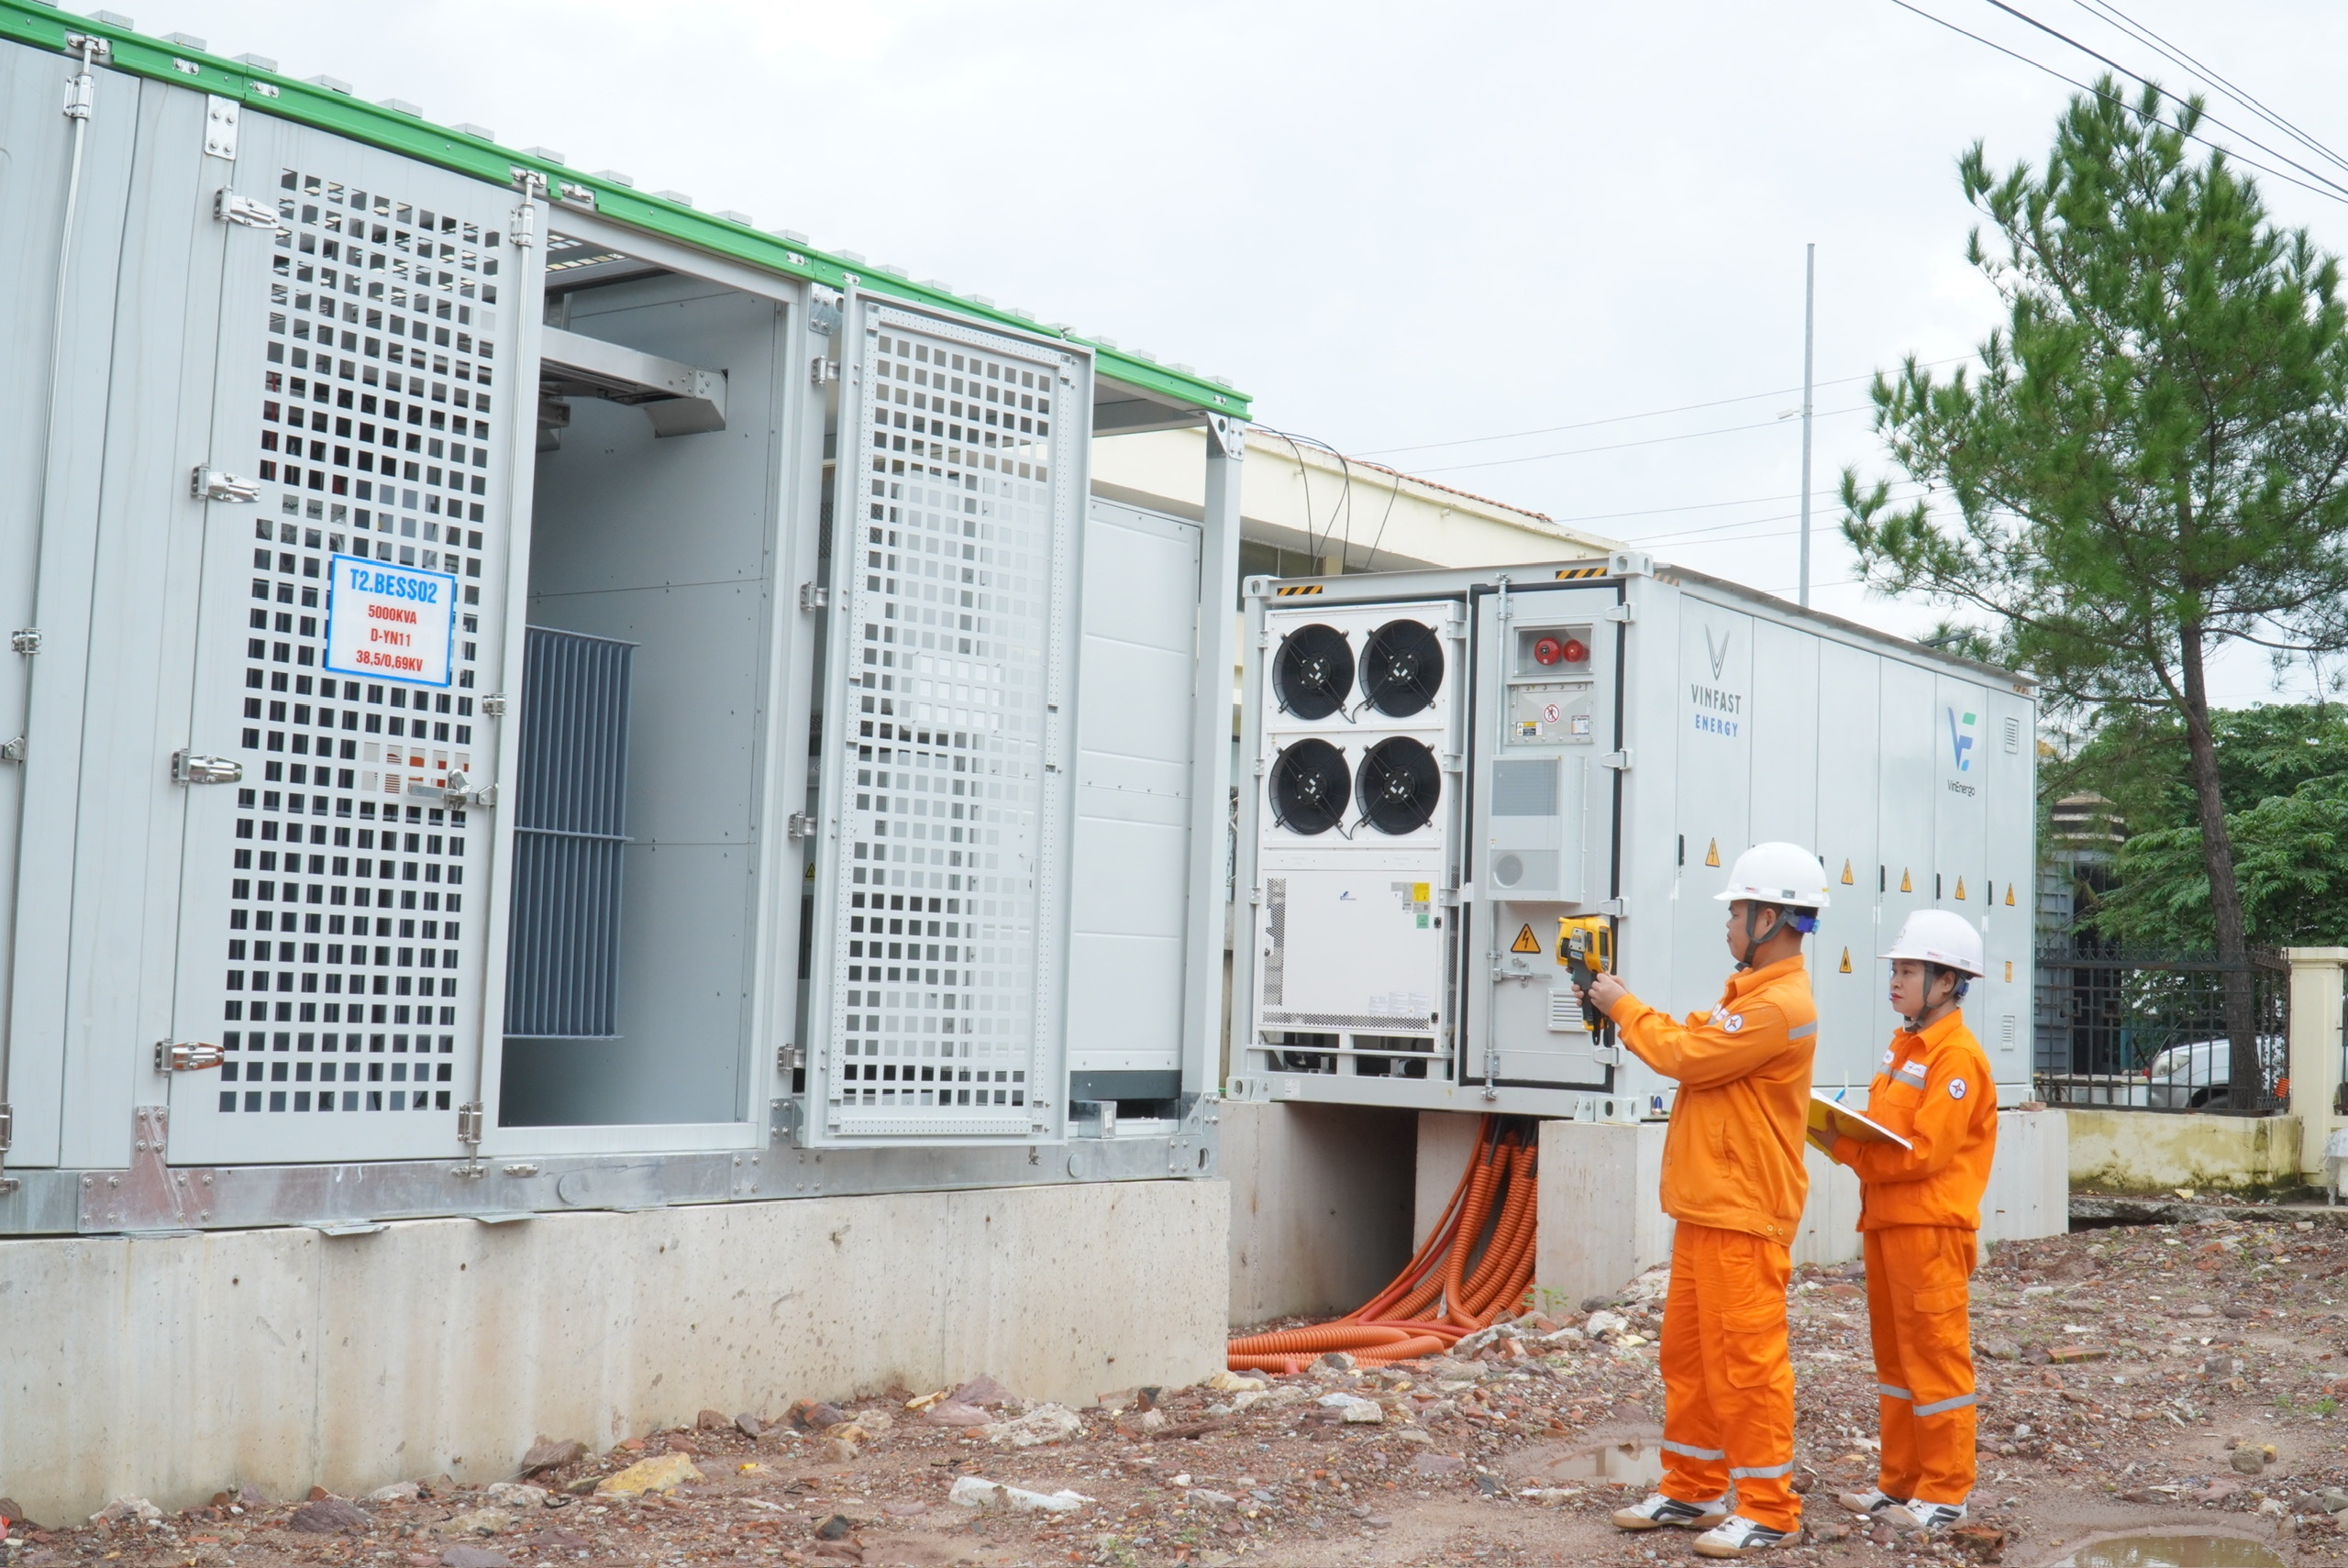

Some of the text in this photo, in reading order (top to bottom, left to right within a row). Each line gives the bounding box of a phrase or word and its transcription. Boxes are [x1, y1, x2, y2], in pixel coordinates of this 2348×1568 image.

[350, 569, 437, 603] T2.BESS02
[368, 604, 417, 624] 5000KVA
[371, 628, 411, 646] D-YN11
[356, 650, 423, 672] 38,5/0,69KV
[1691, 683, 1741, 715] VINFAST
[1695, 713, 1738, 737] ENERGY
